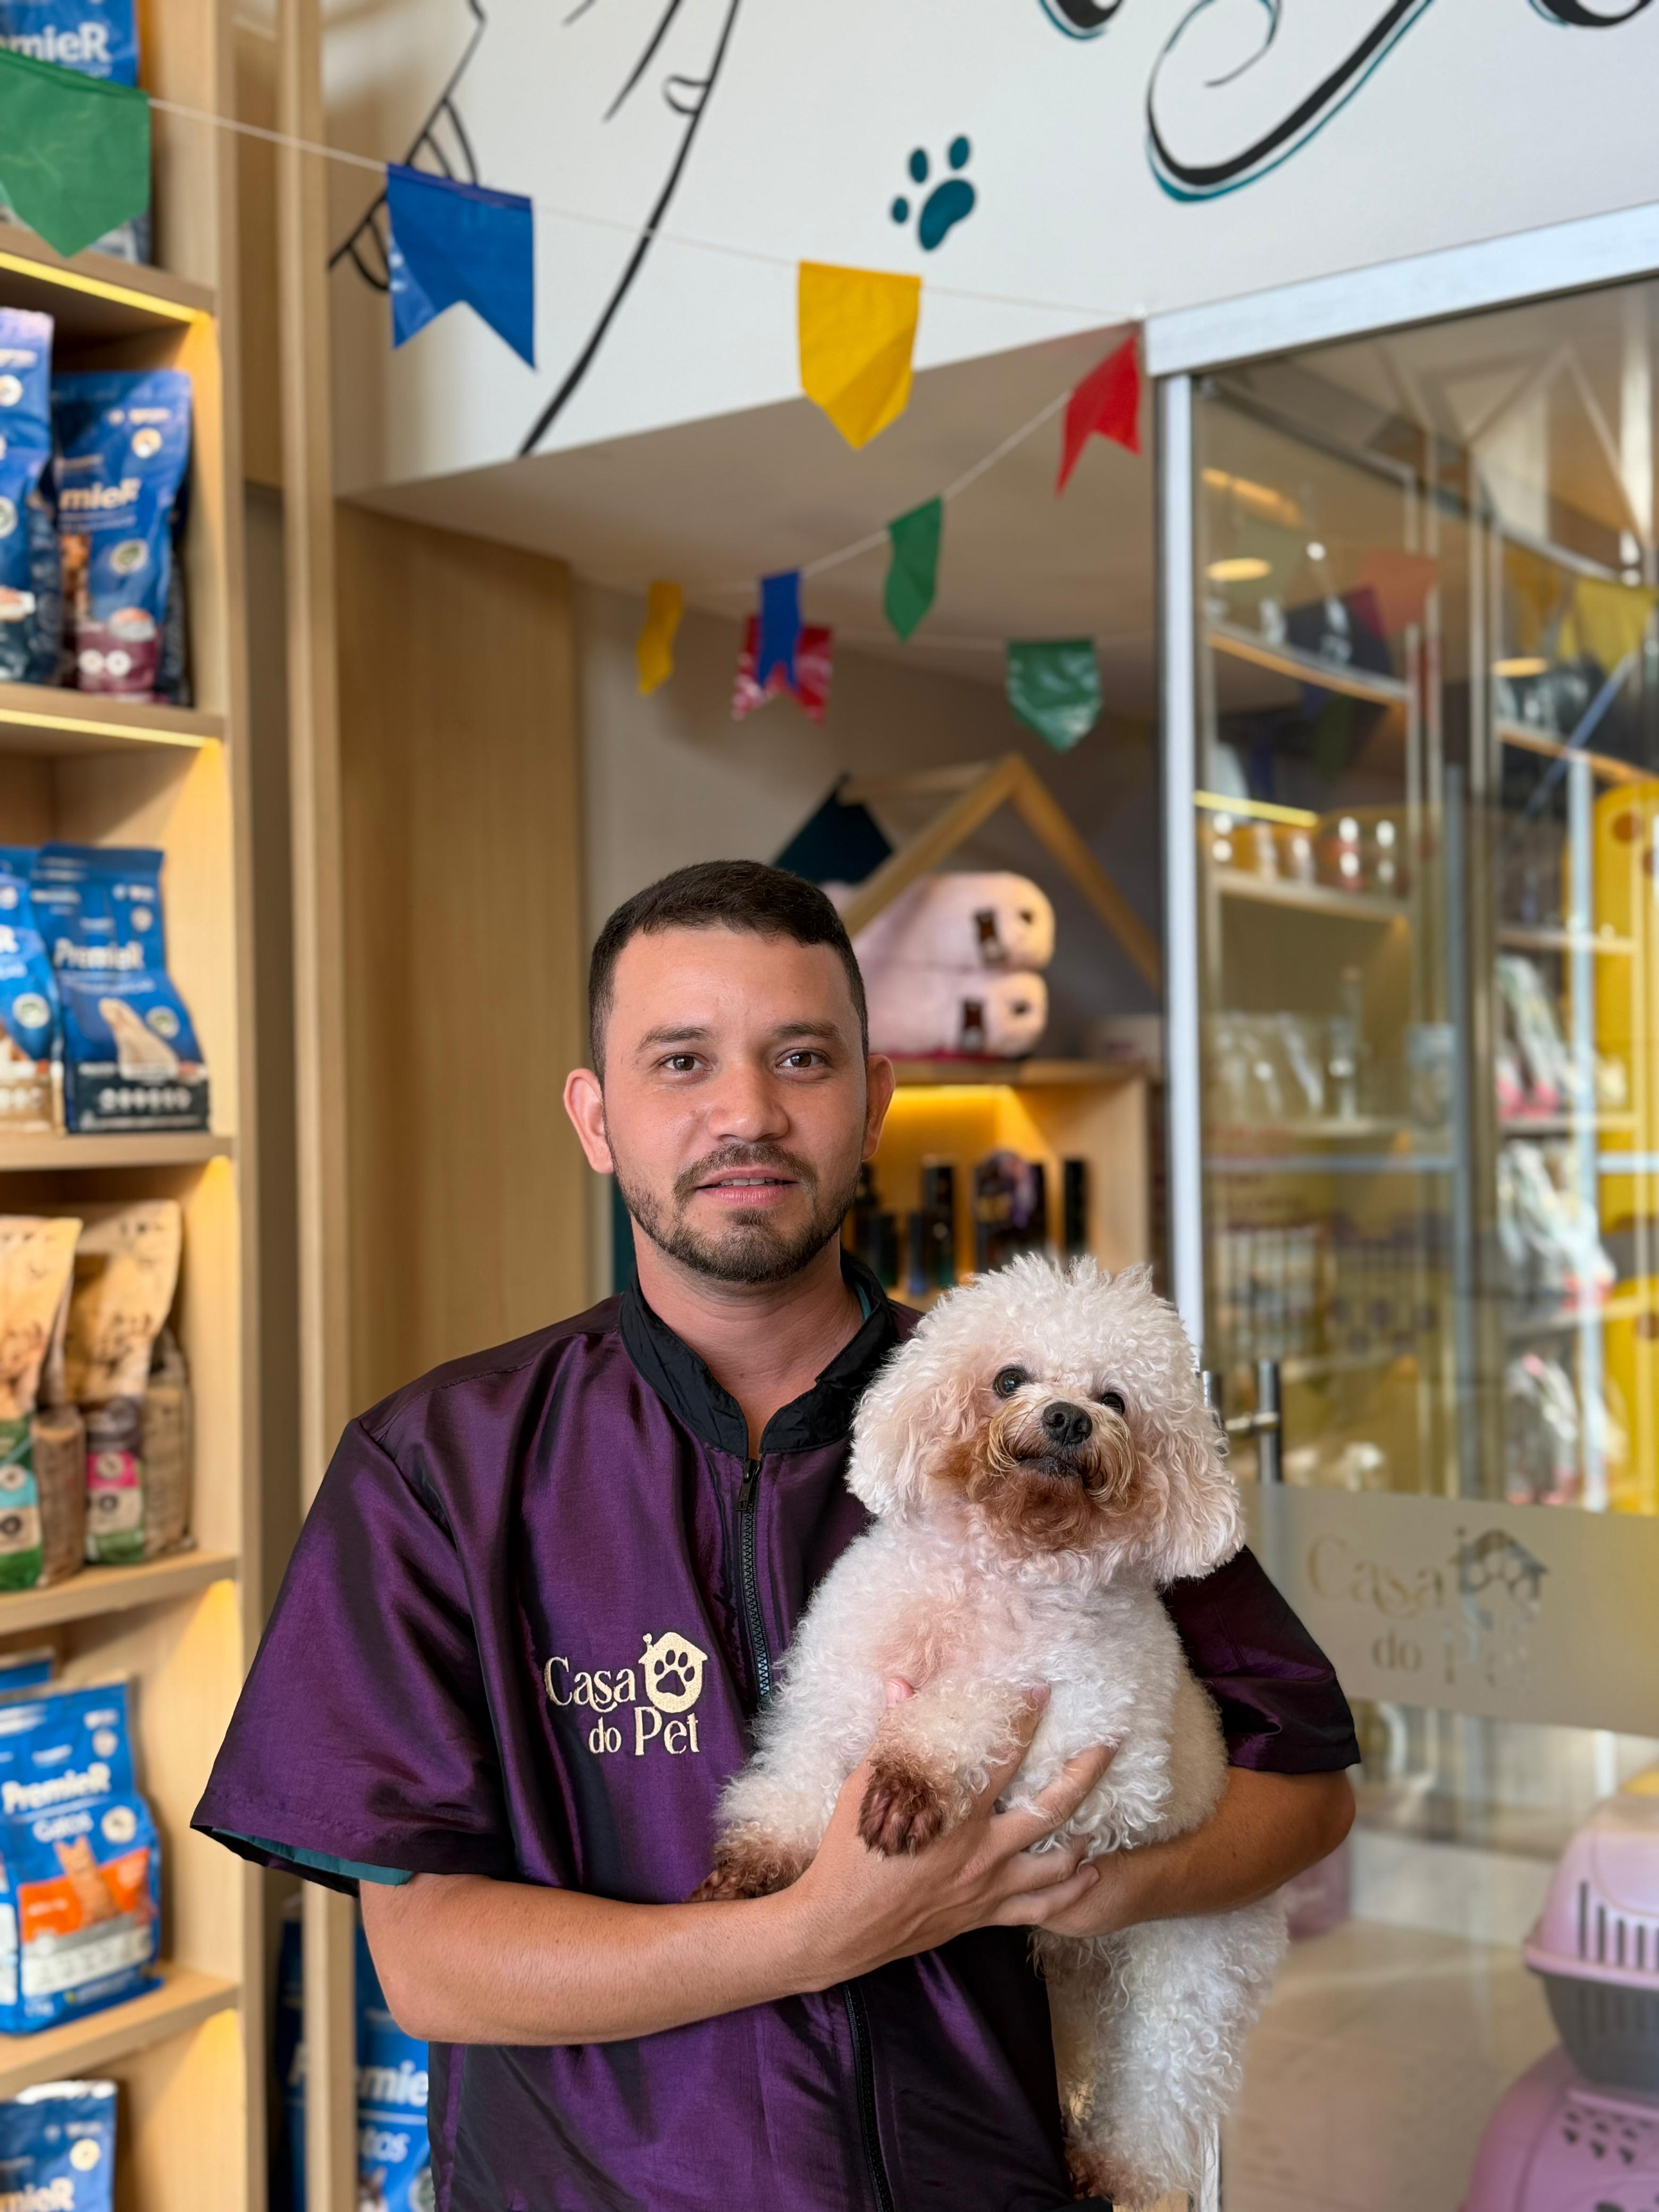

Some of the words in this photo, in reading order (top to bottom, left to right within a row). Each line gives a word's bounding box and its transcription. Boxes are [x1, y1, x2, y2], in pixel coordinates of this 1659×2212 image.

[0, 22, 111, 63] mieR
[1308, 1534, 1444, 1620] Casa
[1371, 1628, 1423, 1672] do
[544, 1656, 637, 1713] Casa
[588, 1717, 622, 1755] do
[634, 1706, 700, 1756] Pet
[2, 1762, 111, 1815] PremieR
